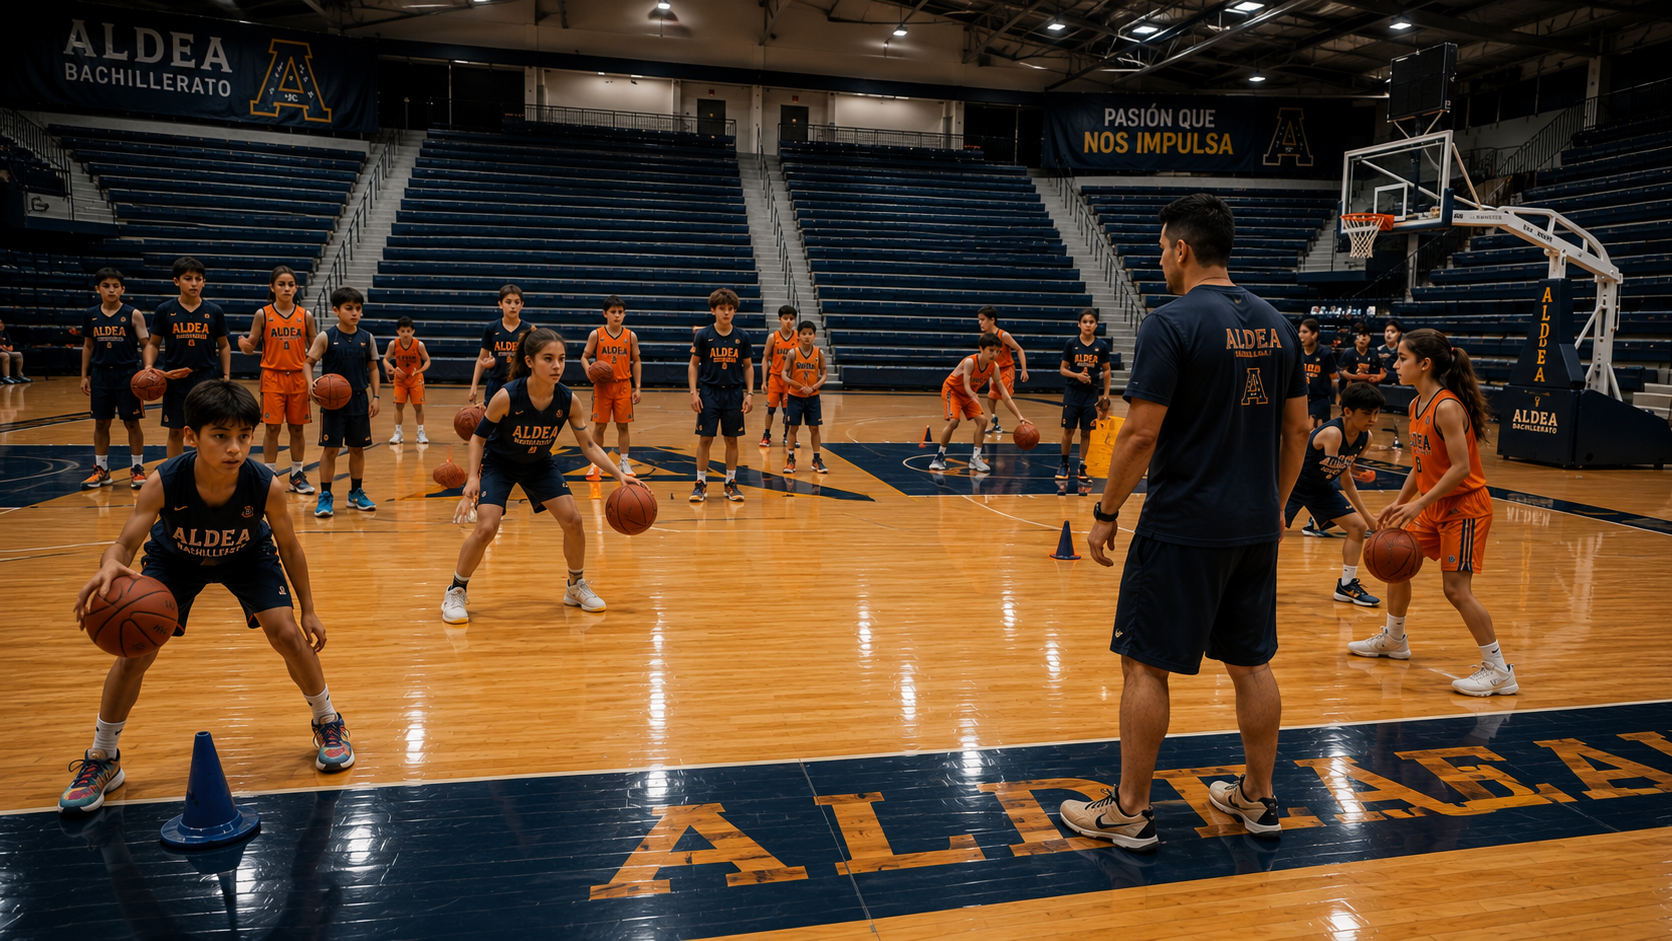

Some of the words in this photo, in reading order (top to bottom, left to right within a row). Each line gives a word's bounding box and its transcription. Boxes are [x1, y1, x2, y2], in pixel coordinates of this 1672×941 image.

[63, 19, 233, 73] ALDEA
[64, 62, 231, 97] BACHILLERATO
[1104, 103, 1173, 128] PASIÓN
[1178, 108, 1216, 130] QUE
[1083, 131, 1129, 154] NOS
[1136, 131, 1234, 155] IMPULSA
[93, 326, 127, 337] ALDEA
[172, 322, 210, 334] ALDEA
[270, 326, 302, 338] ALDEA
[494, 341, 519, 351] ALDE
[1225, 328, 1283, 349] ALDEA
[709, 347, 739, 359] ALDEA
[1512, 409, 1558, 427] ALDEA
[511, 425, 559, 440] ALDEA
[172, 526, 251, 547] ALDEA
